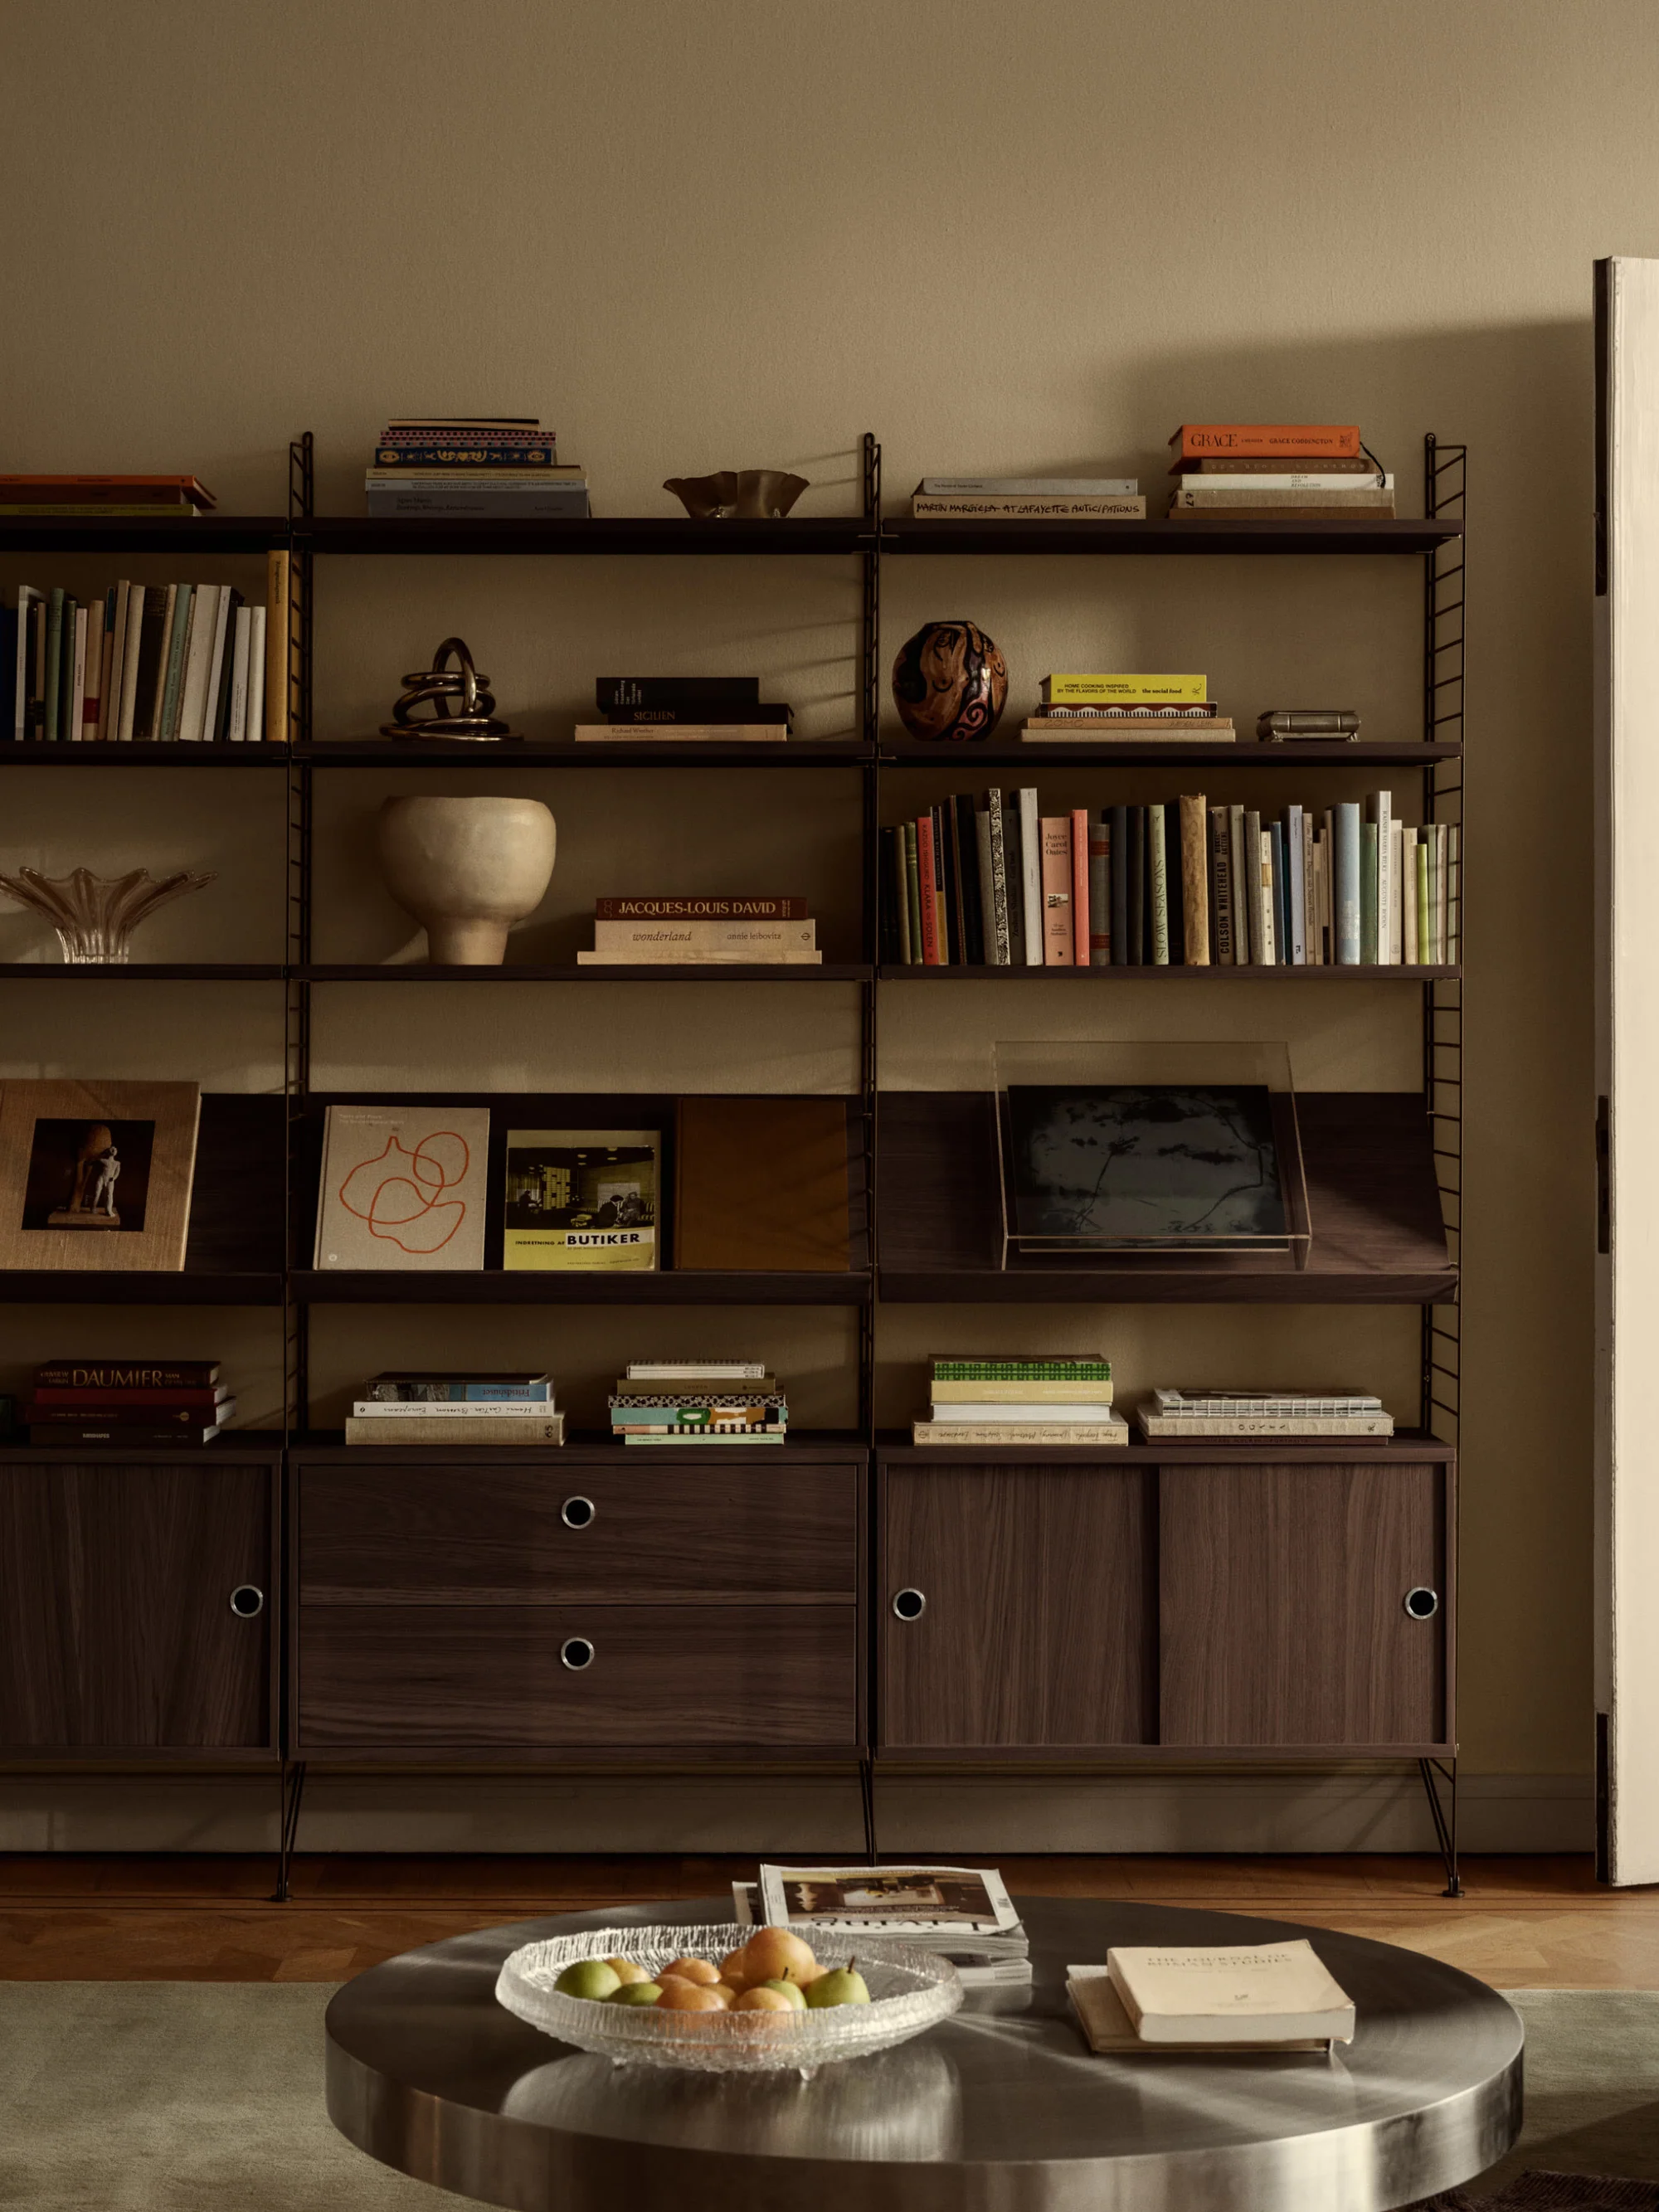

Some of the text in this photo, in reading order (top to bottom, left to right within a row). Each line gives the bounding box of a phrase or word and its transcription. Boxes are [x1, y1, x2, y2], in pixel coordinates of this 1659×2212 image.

[1190, 434, 1238, 447] GRACE
[917, 503, 1140, 513] MARTIN MARGIELA AT LAFAYETTE ANTICIPATIONS
[634, 710, 677, 721] SICILIEN
[619, 902, 730, 916] JACQUES-LOUIS
[732, 902, 776, 914] DAVID
[1154, 858, 1167, 959] SLOW SEASONS
[1217, 862, 1229, 954] COLSON WHITEHEAD
[632, 931, 693, 941] wonderland
[567, 1233, 641, 1246] BUTIKER
[73, 1369, 163, 1388] DAUMIER
[482, 1389, 530, 1398] Fritidshuset
[383, 1405, 426, 1416] Europeans
[506, 1407, 532, 1415] Henri
